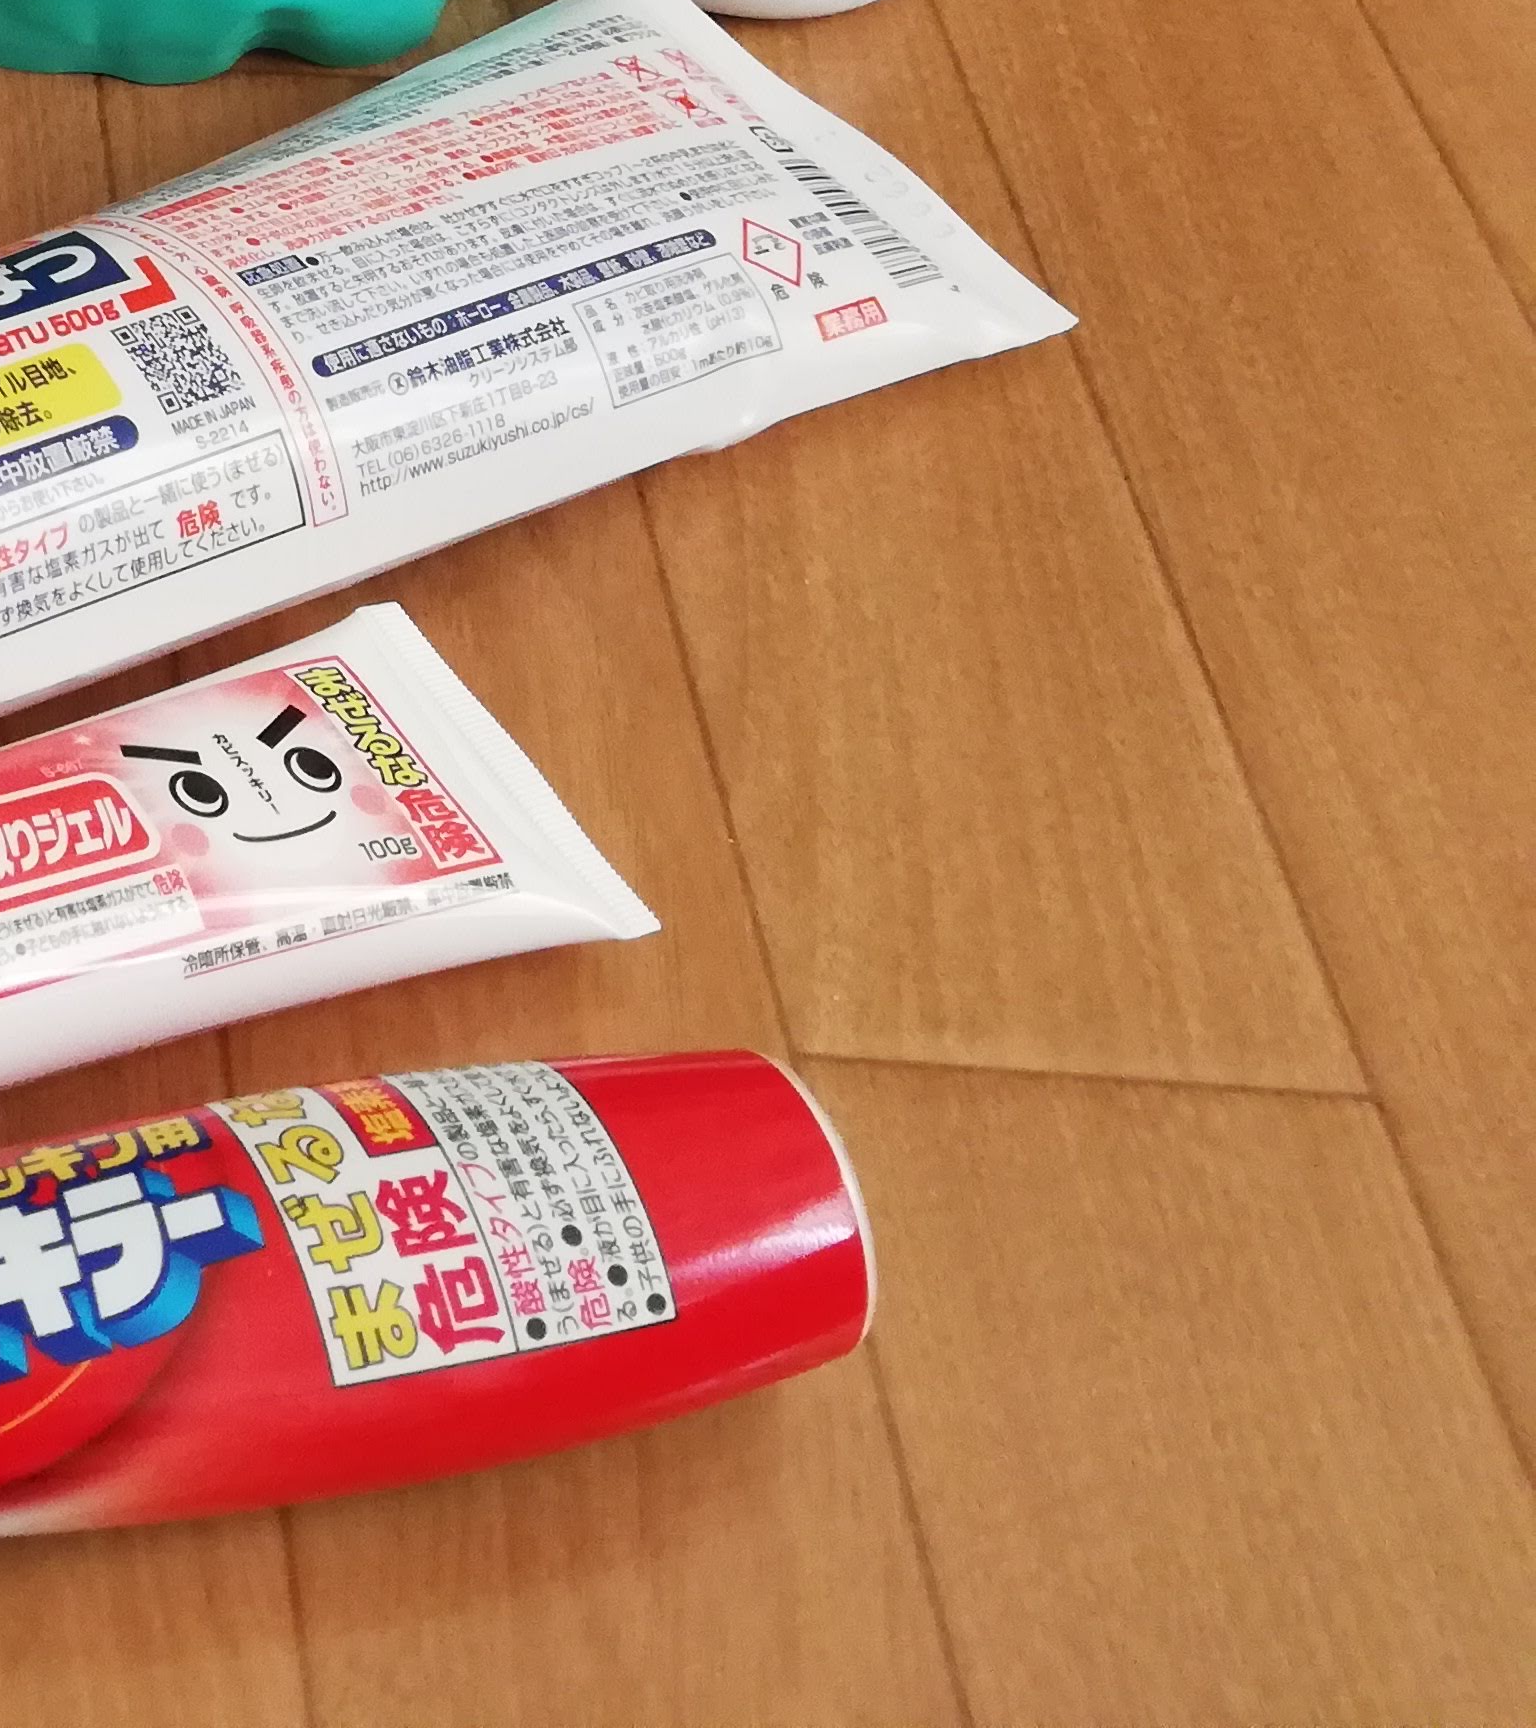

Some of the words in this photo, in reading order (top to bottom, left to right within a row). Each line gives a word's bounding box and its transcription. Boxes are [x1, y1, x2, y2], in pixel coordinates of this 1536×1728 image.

[51, 299, 122, 345] 500g
[819, 300, 885, 340] 業務用
[406, 316, 571, 389] 鈴木油脂工業株式会社
[176, 499, 222, 538] 危険
[294, 666, 485, 864] まぜるな危険
[358, 837, 418, 862] 100g
[375, 1168, 506, 1355] 危険
